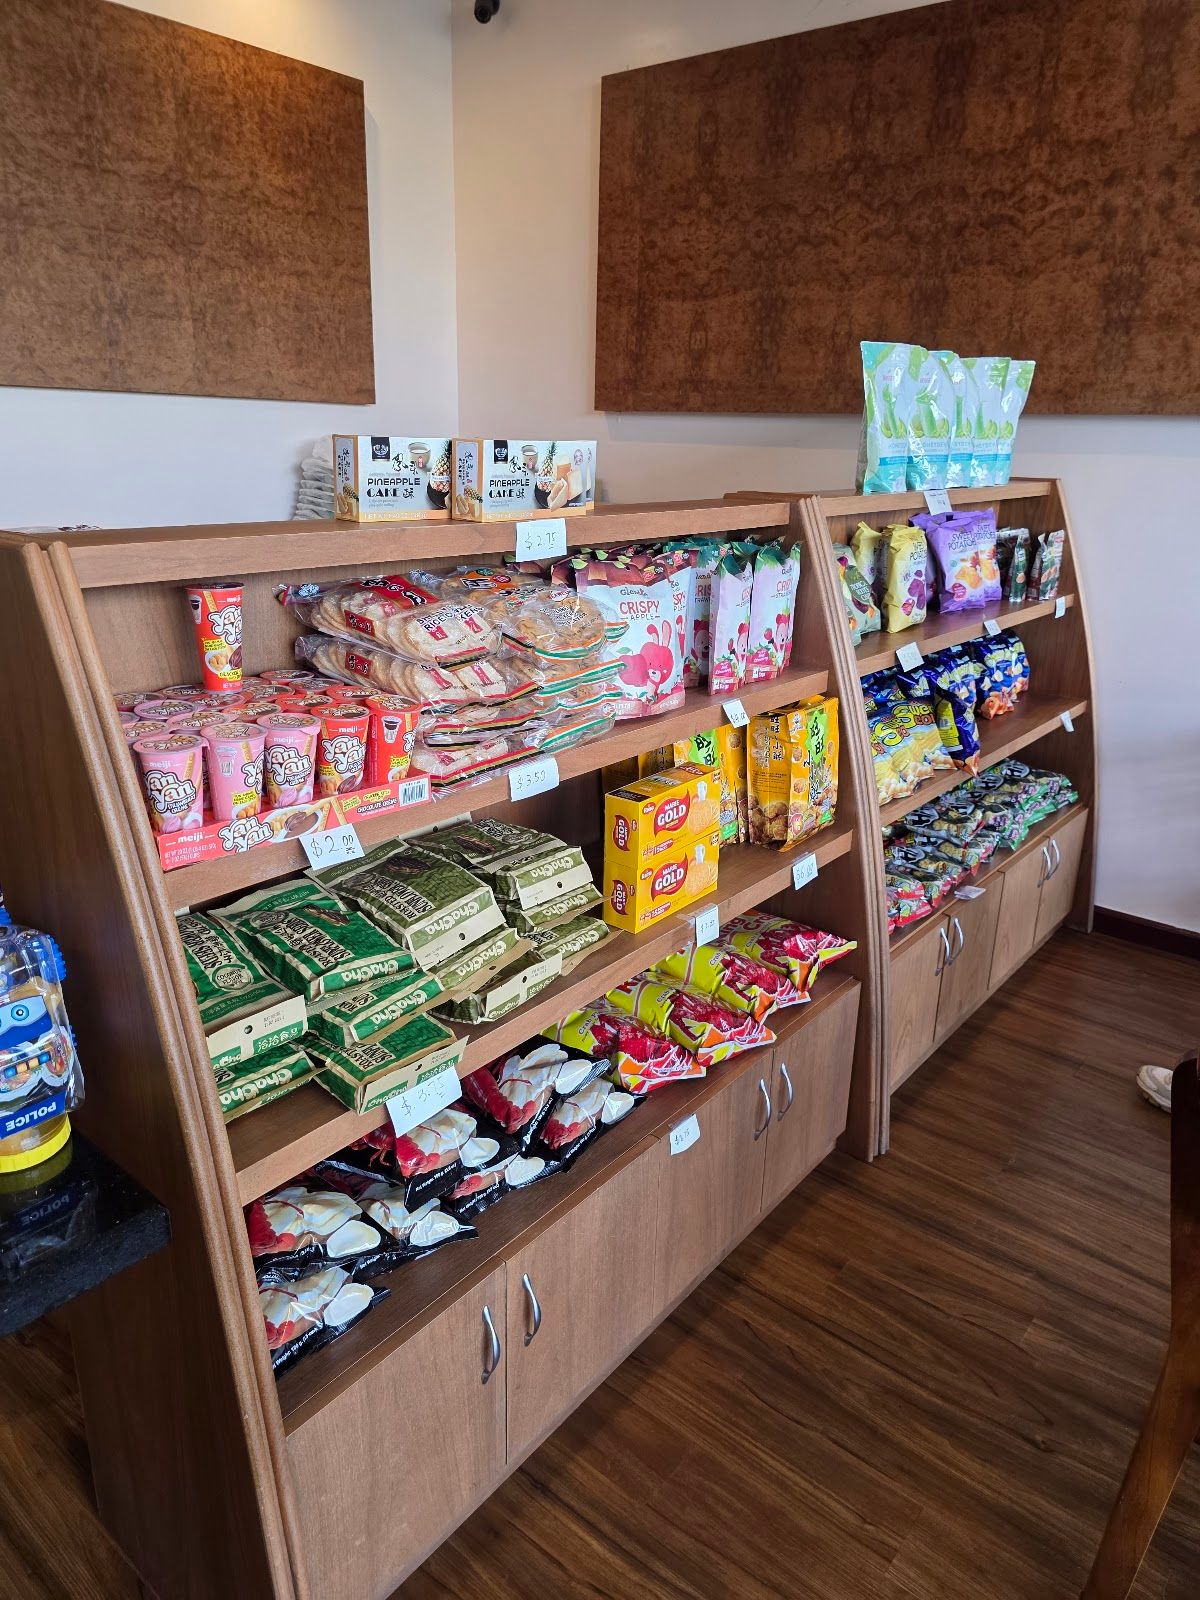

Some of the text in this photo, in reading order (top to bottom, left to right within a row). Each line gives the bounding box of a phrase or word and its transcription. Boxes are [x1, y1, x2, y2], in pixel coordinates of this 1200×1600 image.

[366, 487, 401, 498] CAKE
[367, 477, 421, 486] PINEAPPLE
[489, 478, 530, 488] PINEAPPLE
[488, 488, 515, 499] CAKE
[619, 600, 660, 615] CRISPY
[273, 736, 295, 744] meiji
[339, 725, 358, 734] meiji
[149, 760, 172, 770] meiji
[150, 780, 197, 813] Yan
[657, 804, 687, 827] GOLD
[177, 831, 204, 844] meiji
[218, 816, 258, 851] Yan
[234, 822, 274, 853] Yan
[617, 819, 625, 847] GOLD
[530, 856, 574, 878] ChaCha
[655, 867, 685, 891] GOLD
[542, 893, 589, 917] ChaCha
[424, 900, 480, 936] ChaCha
[340, 959, 399, 982] ChaCha
[456, 940, 508, 978] ChaCha
[370, 989, 428, 1025] ChaCha
[579, 1016, 594, 1035] Crab
[219, 1068, 293, 1105] ChaCha
[6, 1101, 57, 1132] POLICE
